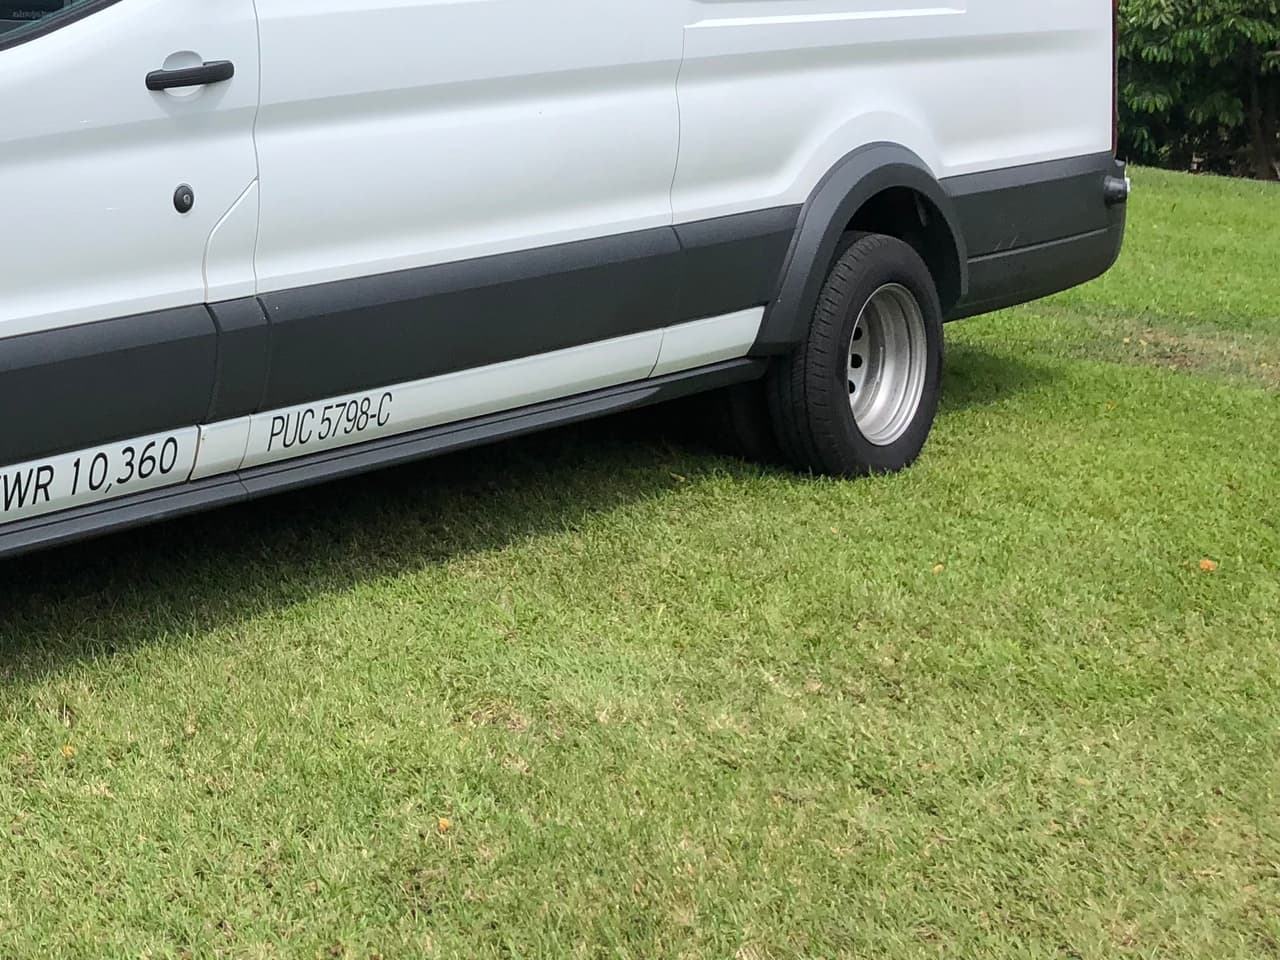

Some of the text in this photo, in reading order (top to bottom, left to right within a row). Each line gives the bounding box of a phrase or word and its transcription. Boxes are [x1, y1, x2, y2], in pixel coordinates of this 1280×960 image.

[267, 391, 393, 452] PUC 5798-C
[70, 436, 179, 496] 10,360
